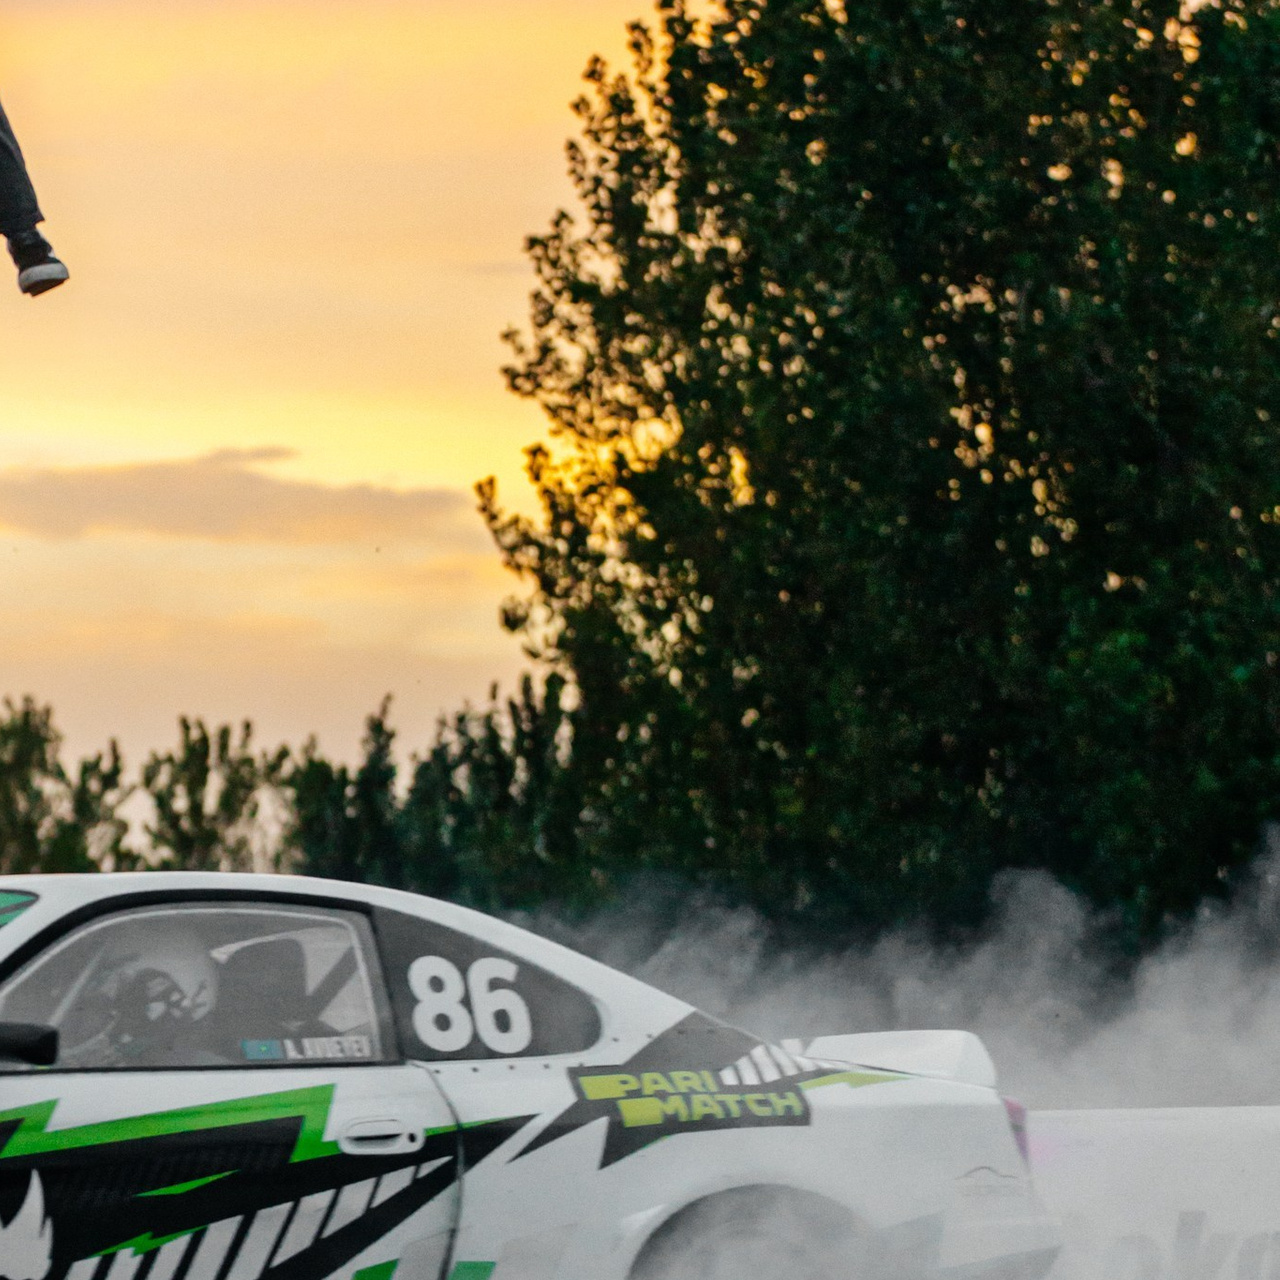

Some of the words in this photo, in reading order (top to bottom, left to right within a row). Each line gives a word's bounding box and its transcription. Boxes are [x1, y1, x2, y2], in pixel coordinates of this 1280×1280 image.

[406, 954, 533, 1055] 86
[578, 1070, 720, 1101] PARI
[617, 1091, 805, 1128] MATCH
